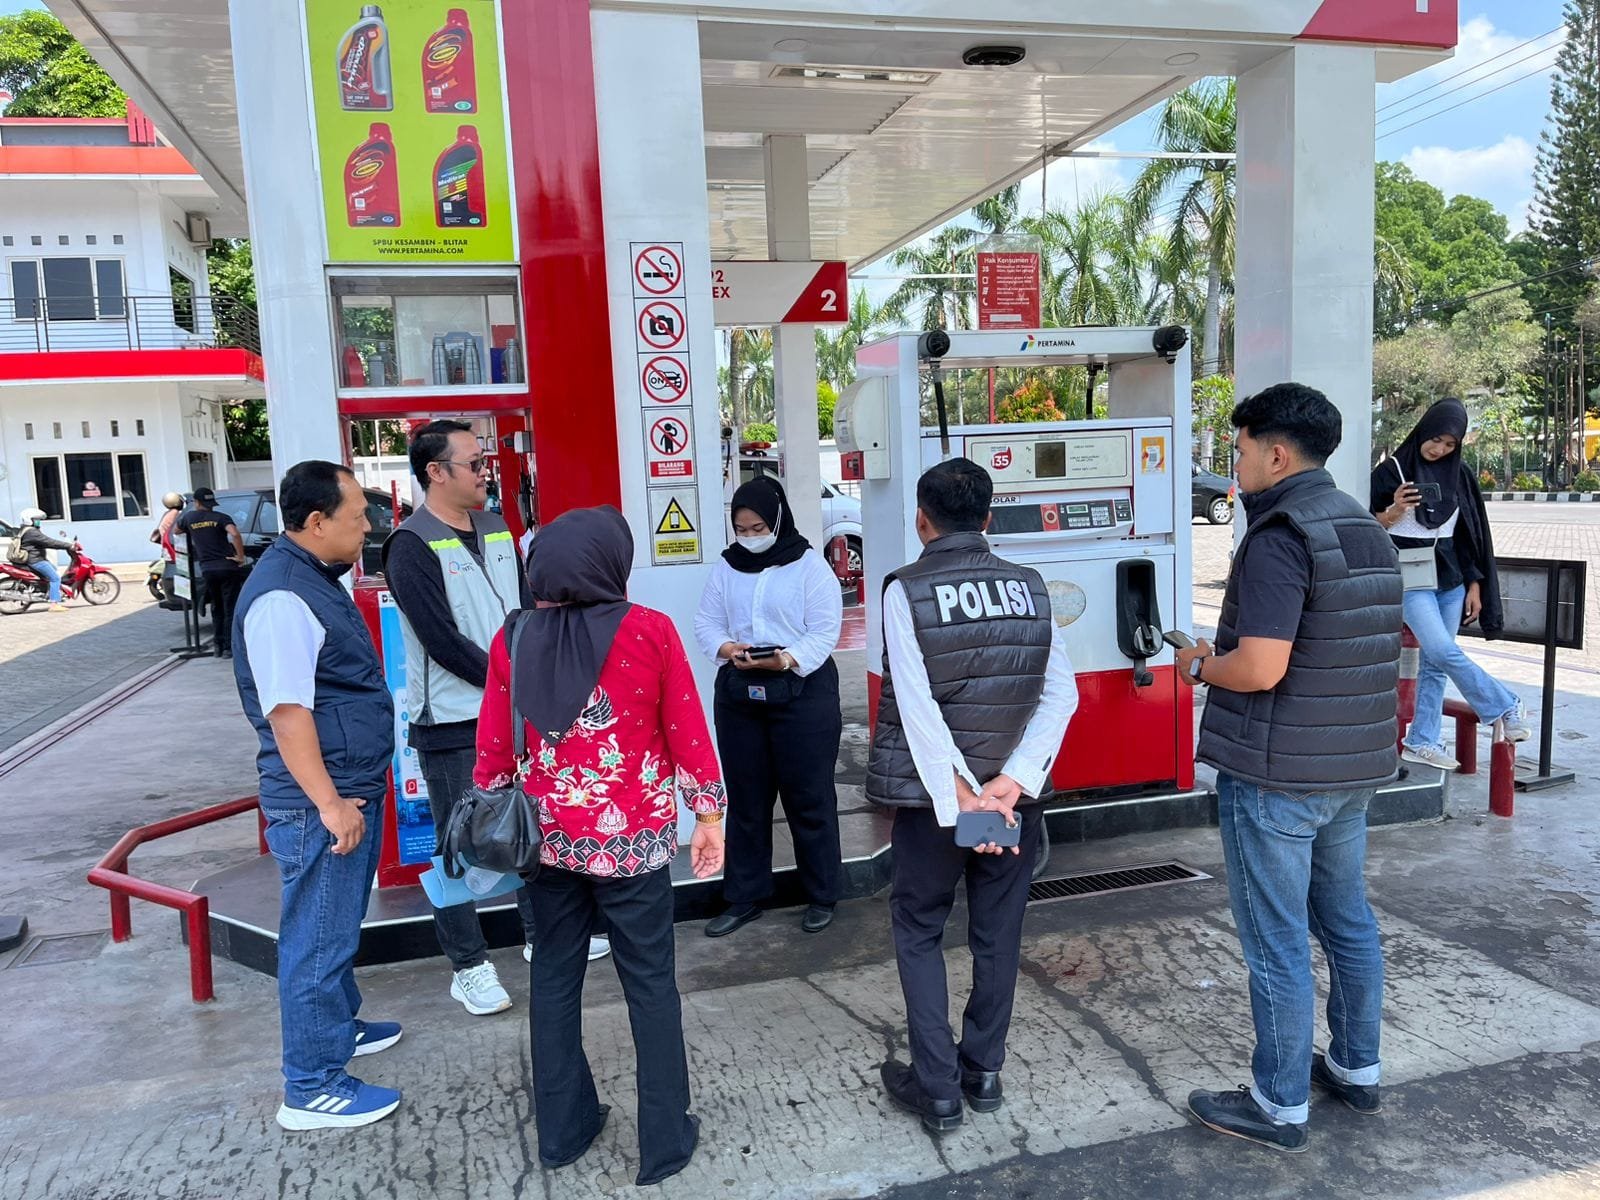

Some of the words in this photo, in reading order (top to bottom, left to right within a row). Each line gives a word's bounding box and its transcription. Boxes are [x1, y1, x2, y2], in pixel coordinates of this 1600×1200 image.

[820, 289, 837, 312] 2
[1037, 340, 1076, 348] PERTAMINA
[650, 376, 664, 384] ON
[991, 496, 1017, 504] OLAR
[190, 520, 218, 530] SECURITY
[935, 580, 1036, 623] POLISI
